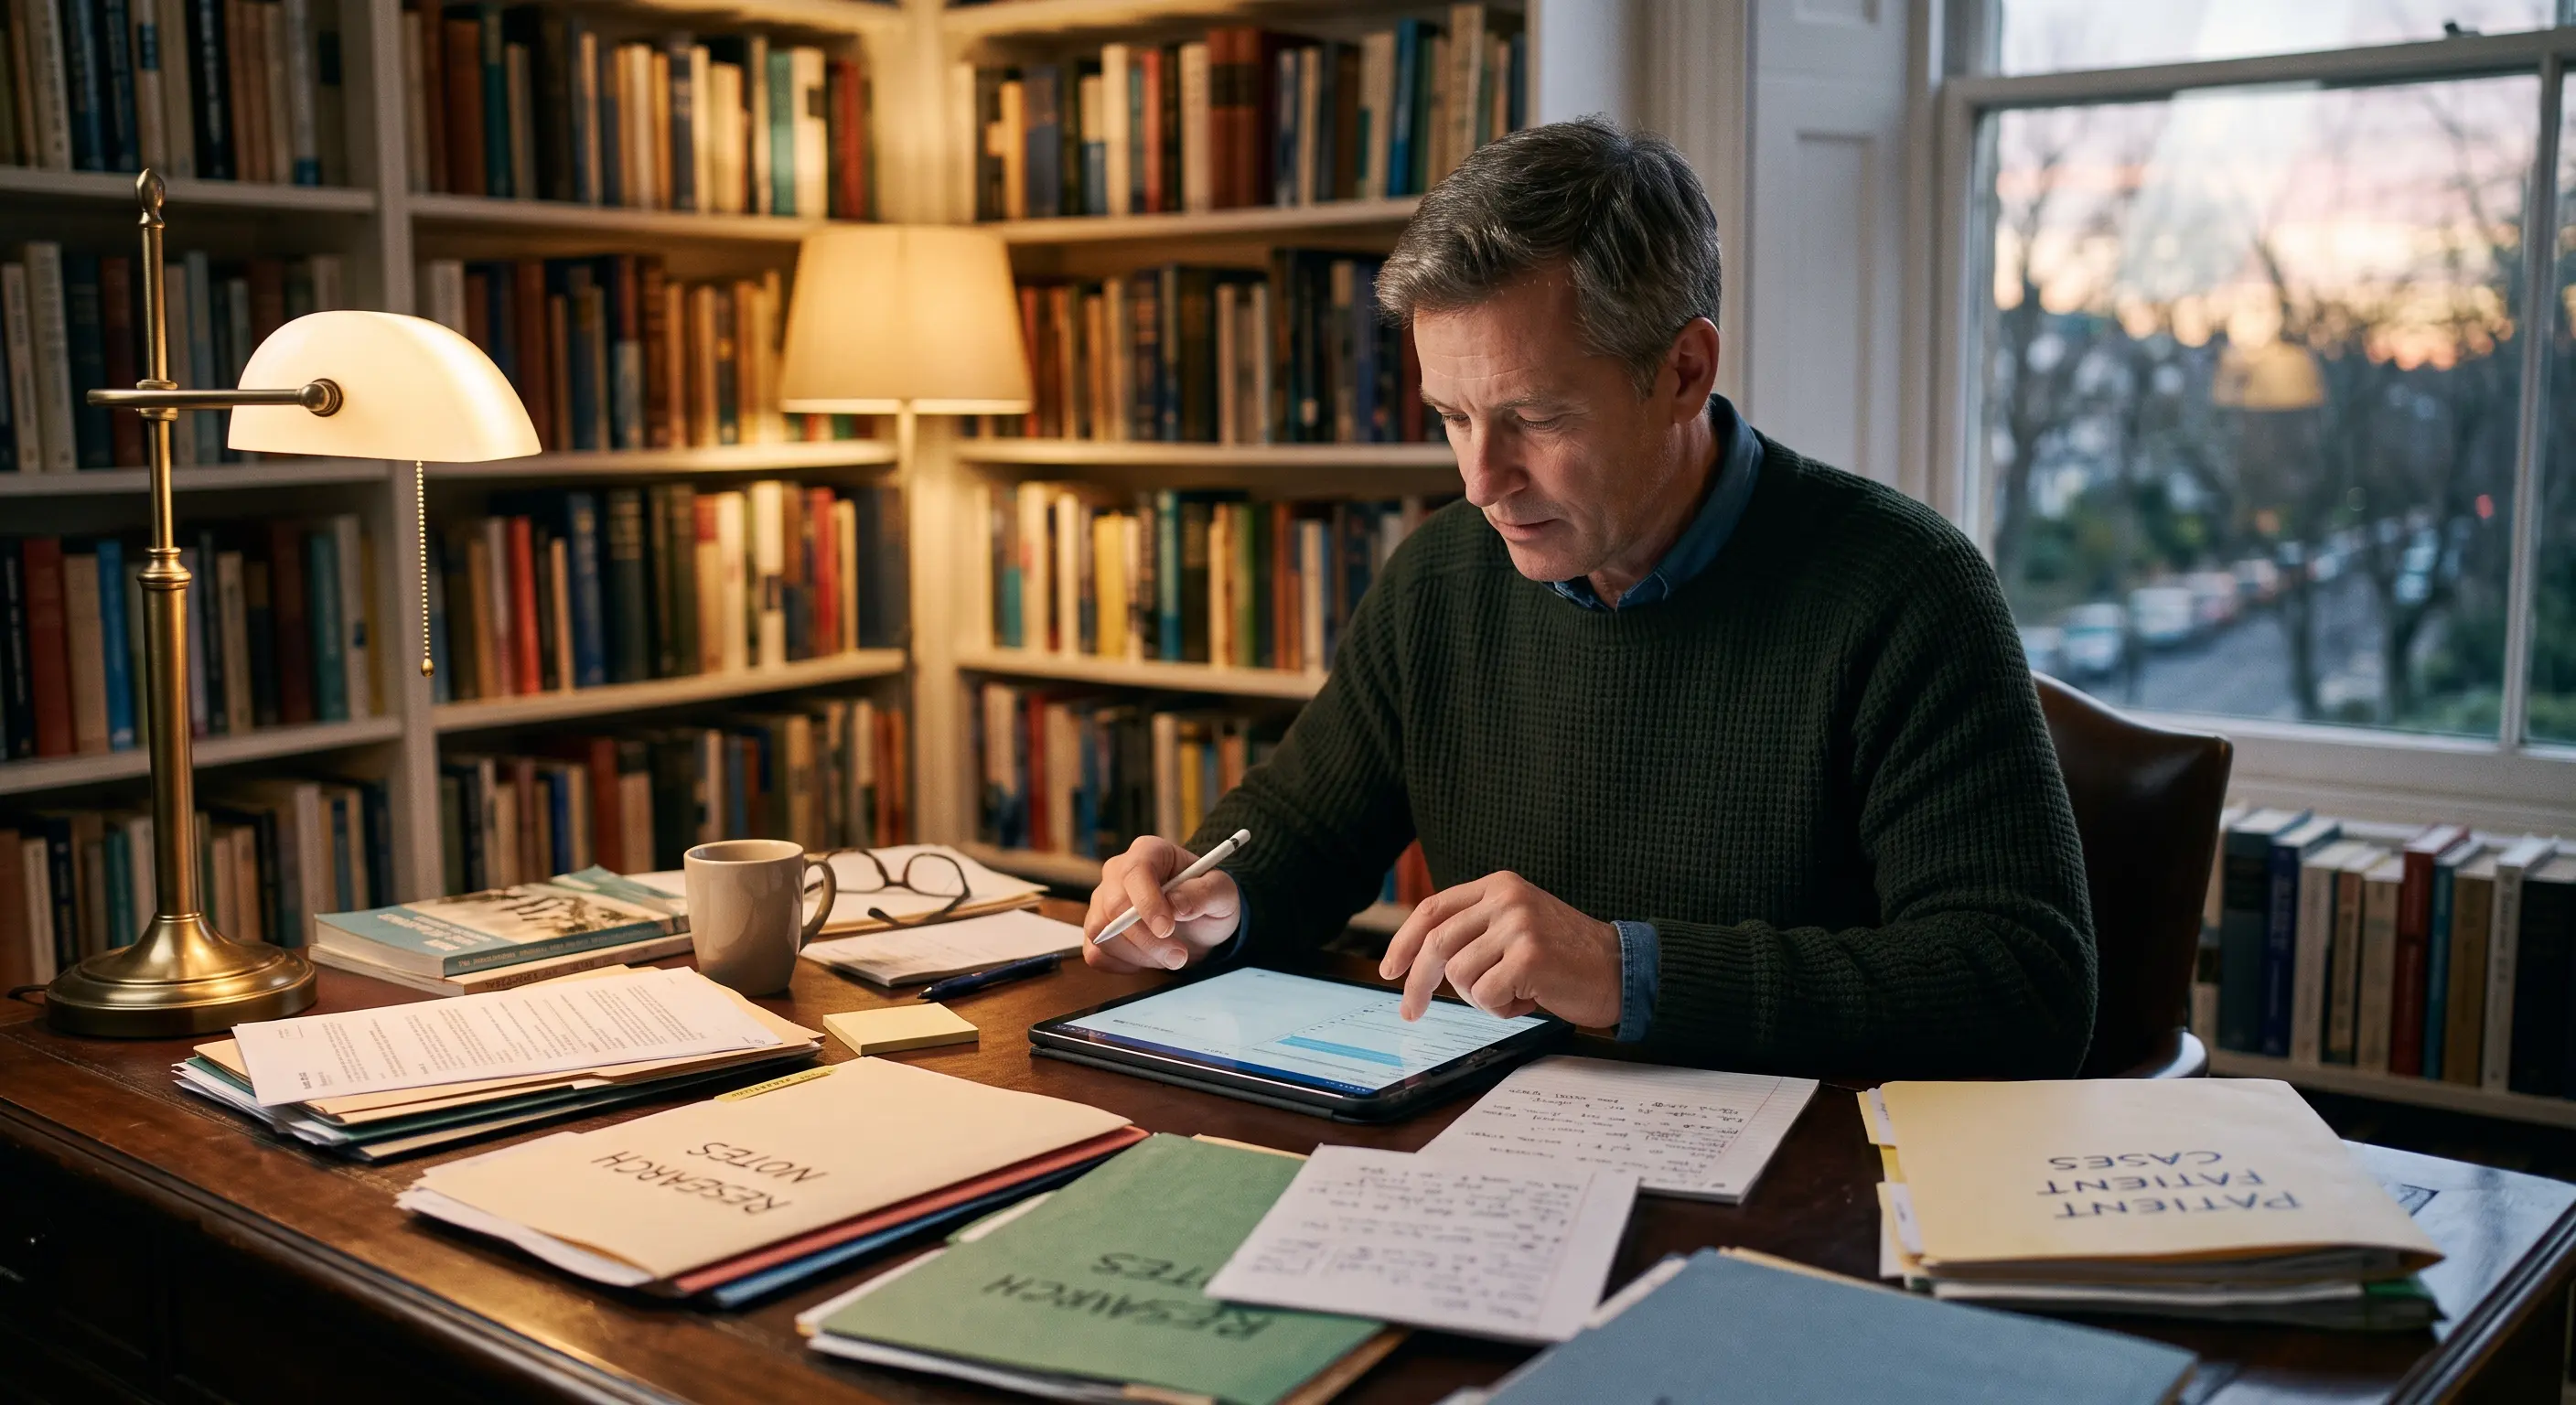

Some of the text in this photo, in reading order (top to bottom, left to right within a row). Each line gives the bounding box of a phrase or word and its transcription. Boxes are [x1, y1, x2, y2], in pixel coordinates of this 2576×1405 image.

[686, 1142, 829, 1184] NOTES
[2047, 1150, 2223, 1171] CASES
[591, 1151, 791, 1214] RESEARCH
[2054, 1191, 2303, 1219] PATIENT
[1089, 1251, 1213, 1291] TES
